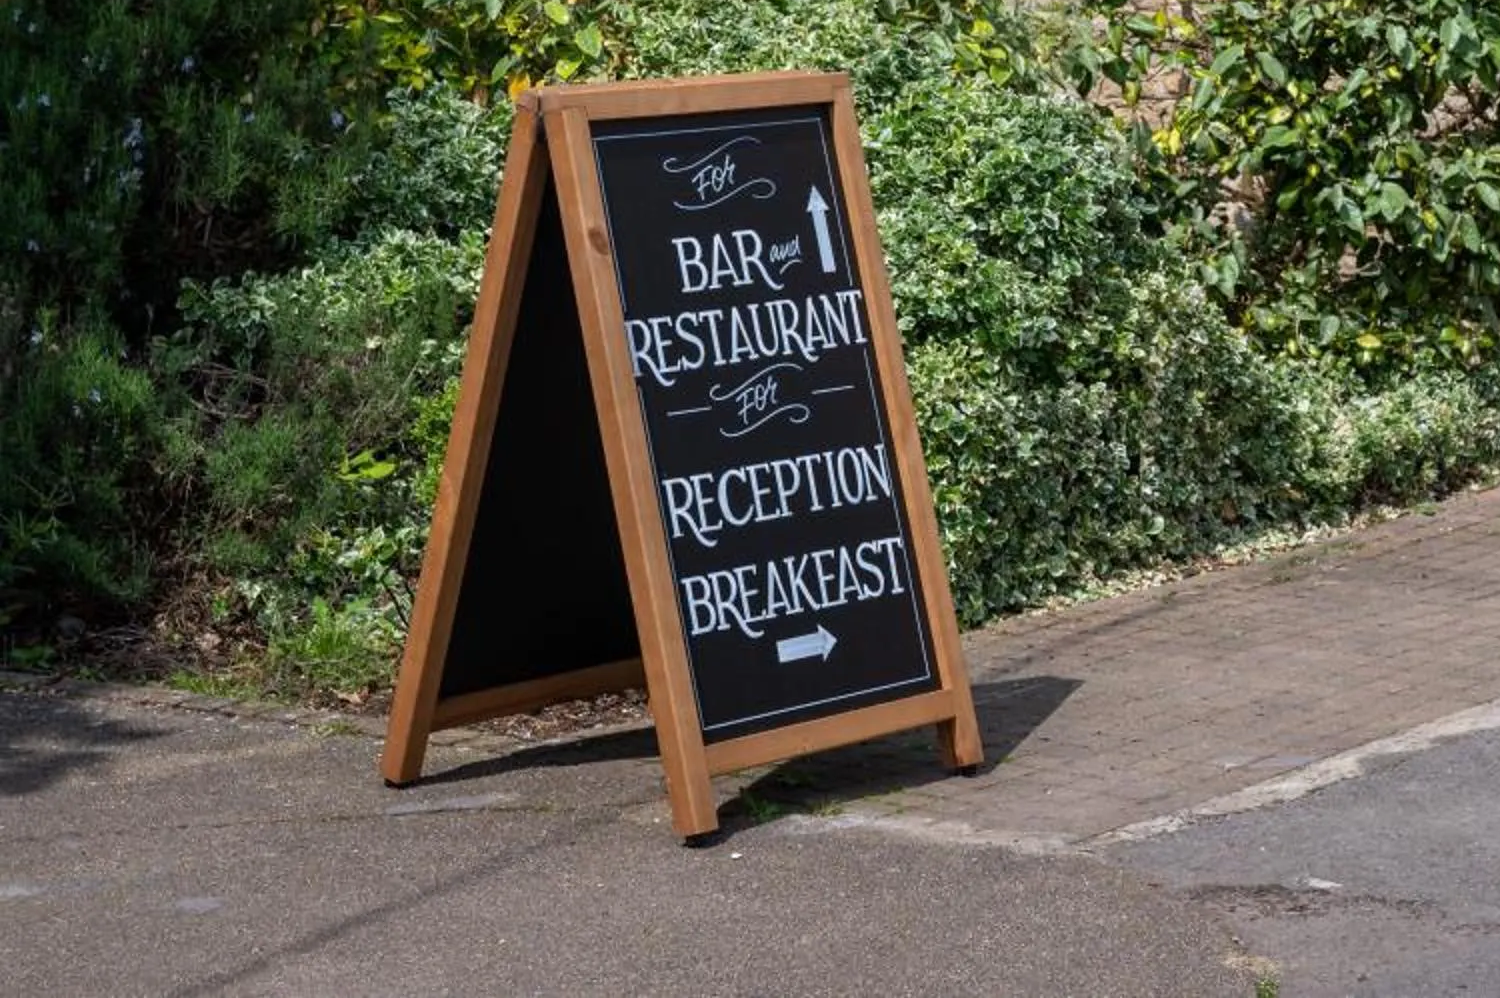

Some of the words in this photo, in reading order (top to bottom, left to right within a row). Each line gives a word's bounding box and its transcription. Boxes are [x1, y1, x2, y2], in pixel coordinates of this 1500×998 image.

[671, 228, 785, 293] BAR
[624, 289, 868, 387] RESTAURANT
[661, 443, 893, 548] RECEPTION
[681, 536, 905, 639] BREAKFAST
